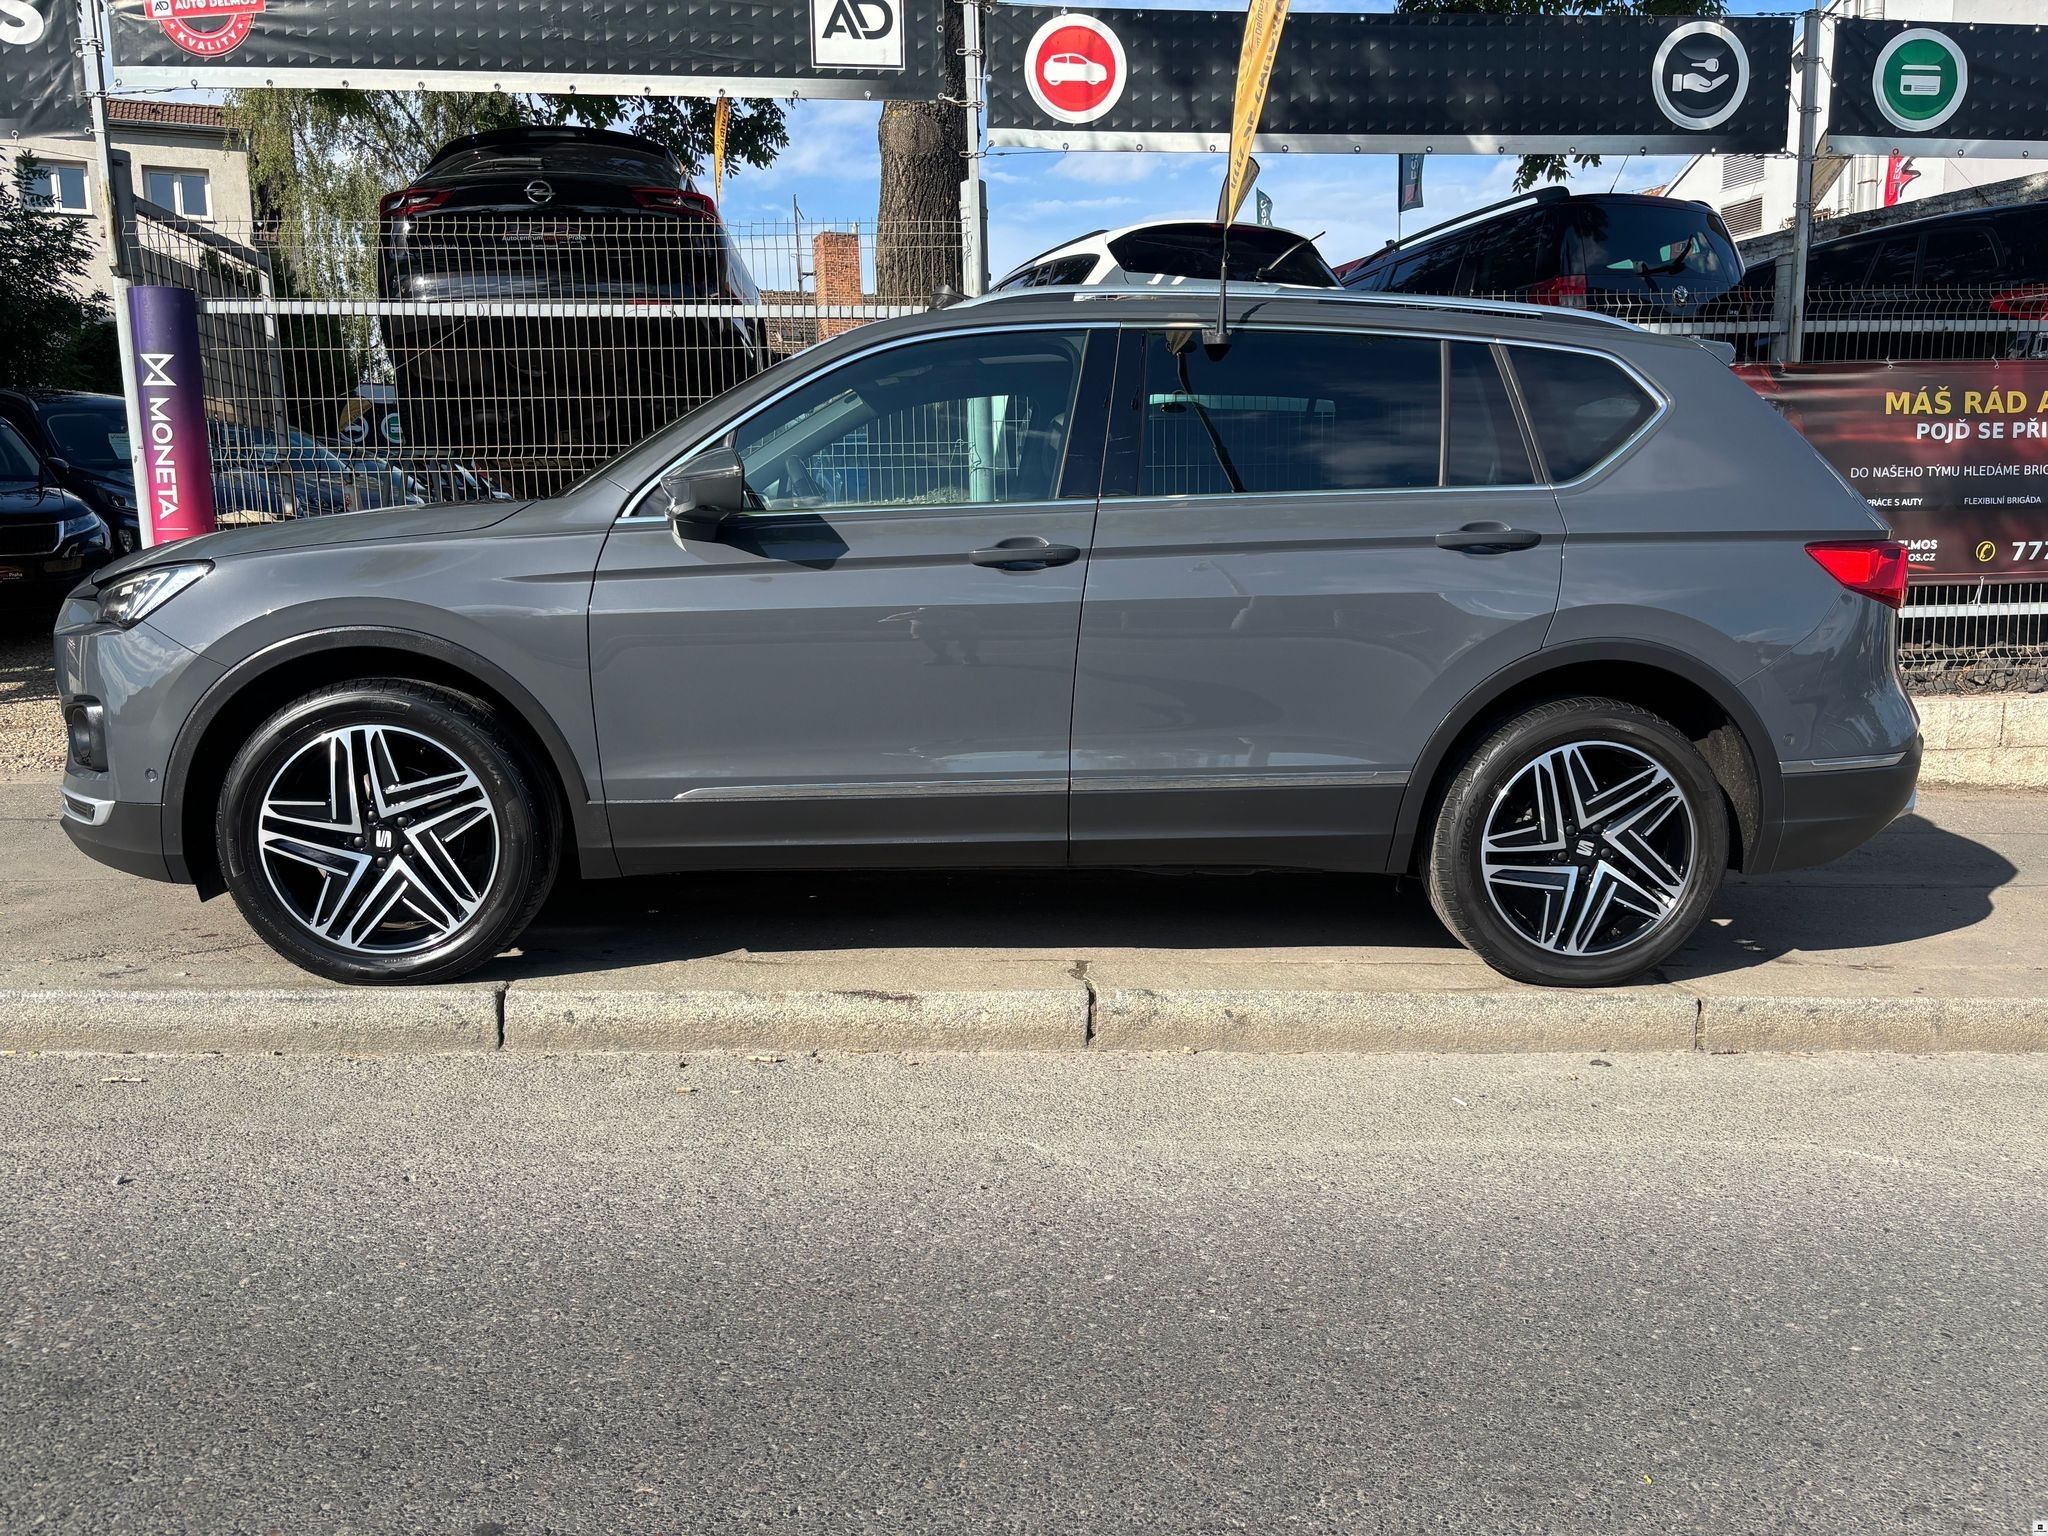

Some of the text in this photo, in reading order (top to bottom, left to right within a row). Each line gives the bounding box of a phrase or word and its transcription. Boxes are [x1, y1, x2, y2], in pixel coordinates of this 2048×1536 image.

[175, 0, 206, 11] AUTO
[821, 0, 894, 40] AD
[177, 31, 237, 51] KVALITY
[1885, 385, 1952, 415] MÁŠ
[1964, 385, 2027, 414] RÁD
[1916, 417, 2048, 443] POJĎ SE PŘI
[149, 397, 179, 520] MONETA
[1850, 467, 1869, 478] DO
[1873, 464, 1924, 478] NAŠEHO
[1926, 464, 1960, 477] TÝMU
[1964, 463, 2020, 477] HLEDÁME
[1894, 498, 1900, 506] S
[1901, 498, 1923, 506] AUTY
[1964, 495, 2042, 505] FLEXIBILNÍ BRIGÁDA
